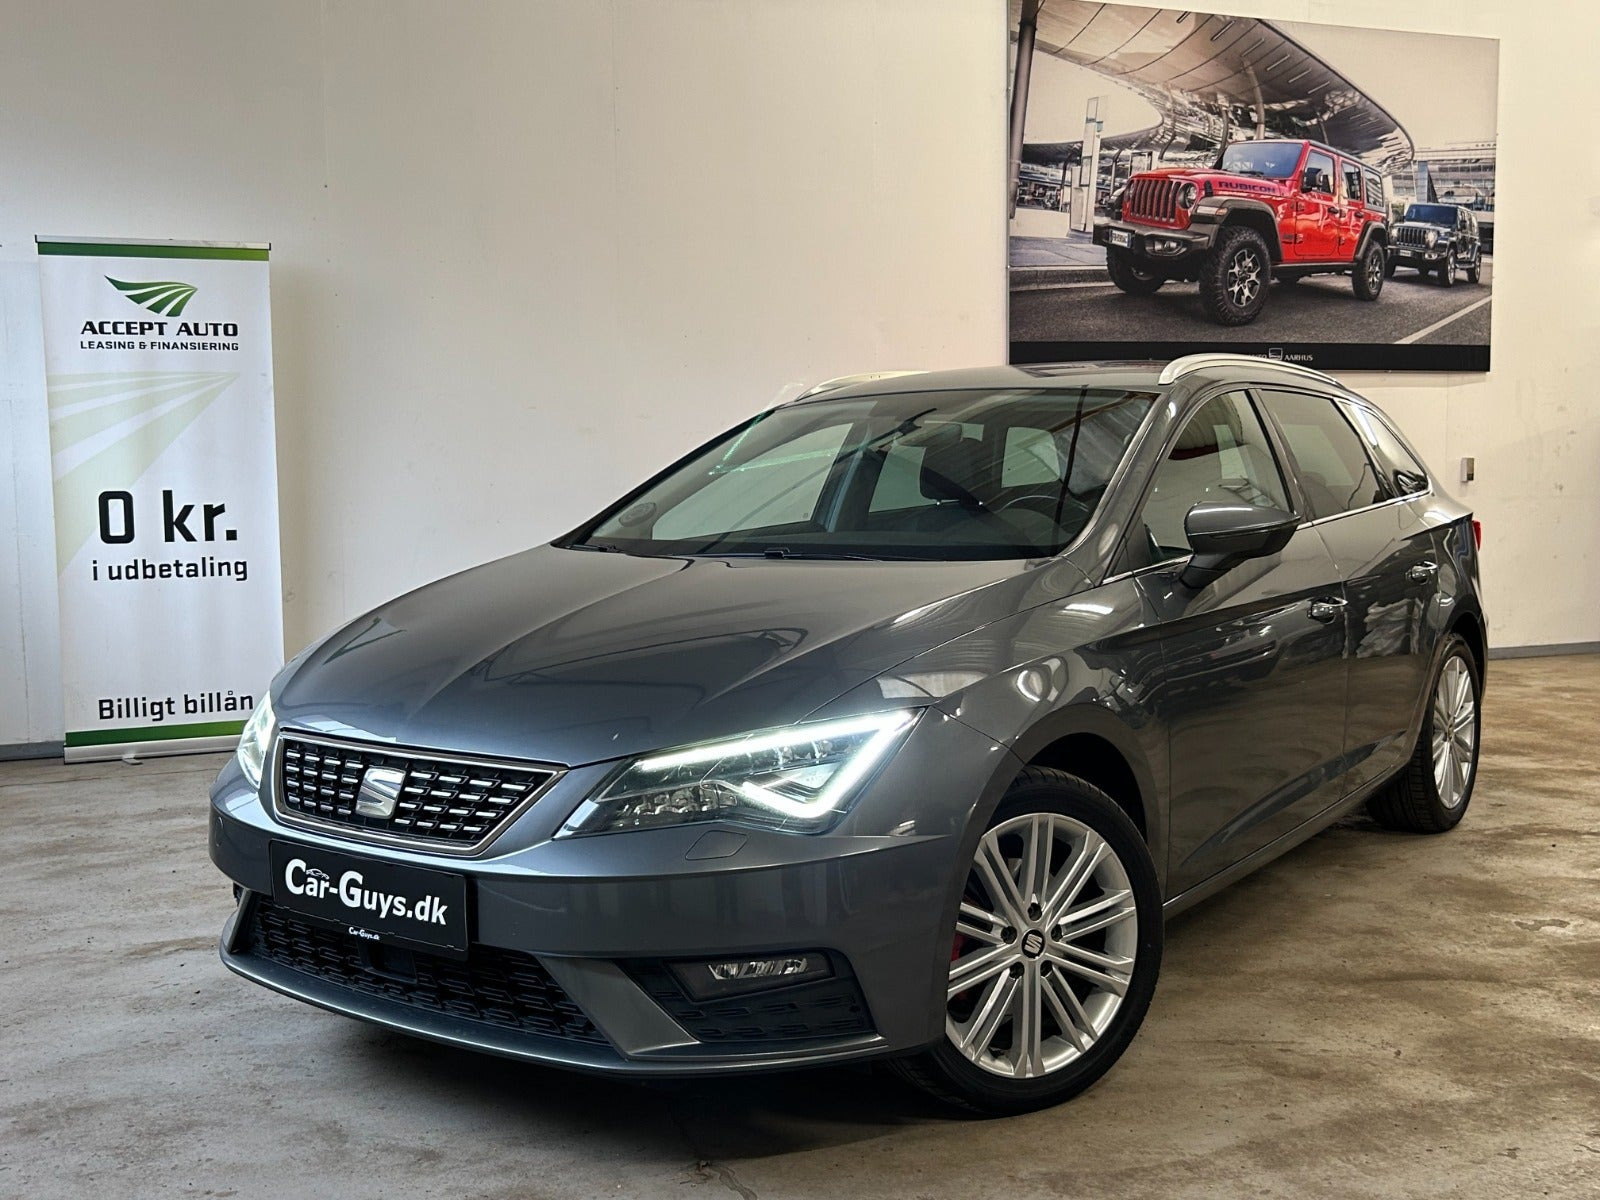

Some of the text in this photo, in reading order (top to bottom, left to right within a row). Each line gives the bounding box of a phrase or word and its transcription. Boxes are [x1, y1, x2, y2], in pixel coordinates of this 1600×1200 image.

[1218, 181, 1277, 194] RUBICON
[80, 320, 239, 337] ACCEPT AUTO
[80, 340, 239, 351] LEASING & FINANSIERING
[1284, 354, 1314, 362] AARHUS
[98, 489, 238, 545] 0 kr.
[92, 556, 249, 582] i udbetaling
[98, 690, 254, 722] Billigt billån
[284, 858, 449, 926] Car-Guys.dk
